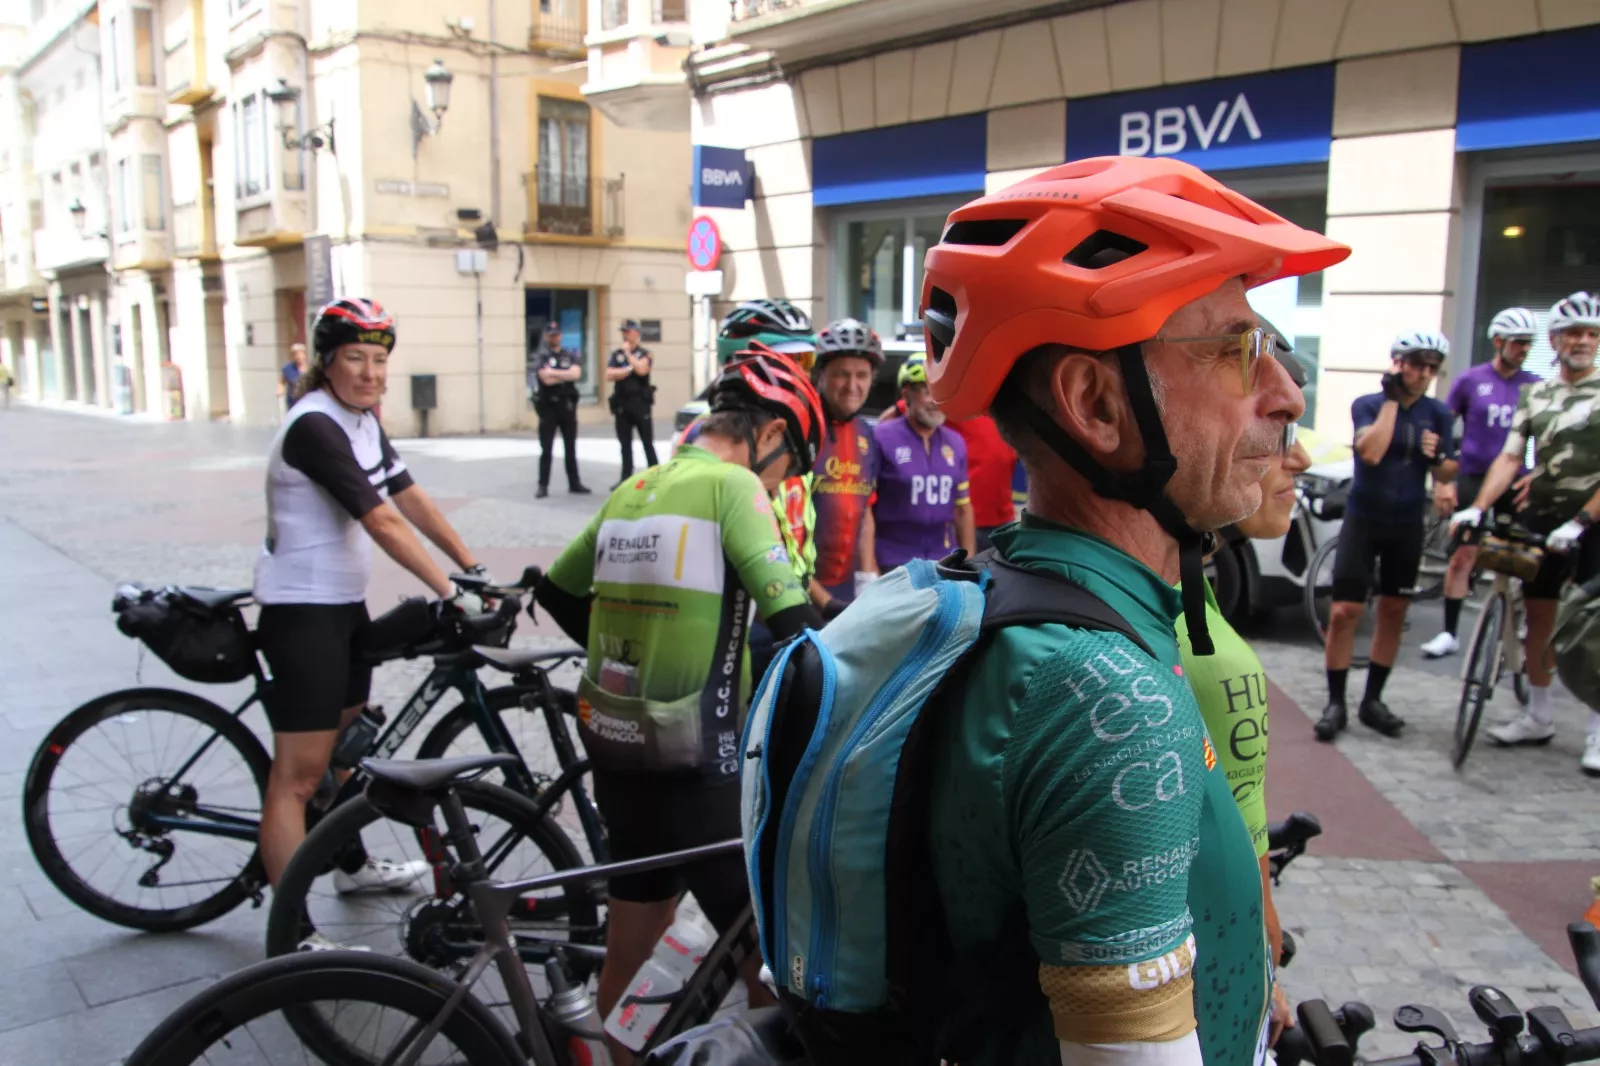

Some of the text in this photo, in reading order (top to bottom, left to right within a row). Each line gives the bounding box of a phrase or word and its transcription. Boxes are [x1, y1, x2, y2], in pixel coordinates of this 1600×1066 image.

[1119, 92, 1262, 157] BBVA
[702, 167, 743, 186] BBVA
[1487, 403, 1517, 428] PC
[911, 474, 953, 505] PCB
[609, 534, 660, 550] RENAULT
[357, 680, 441, 781] TREK
